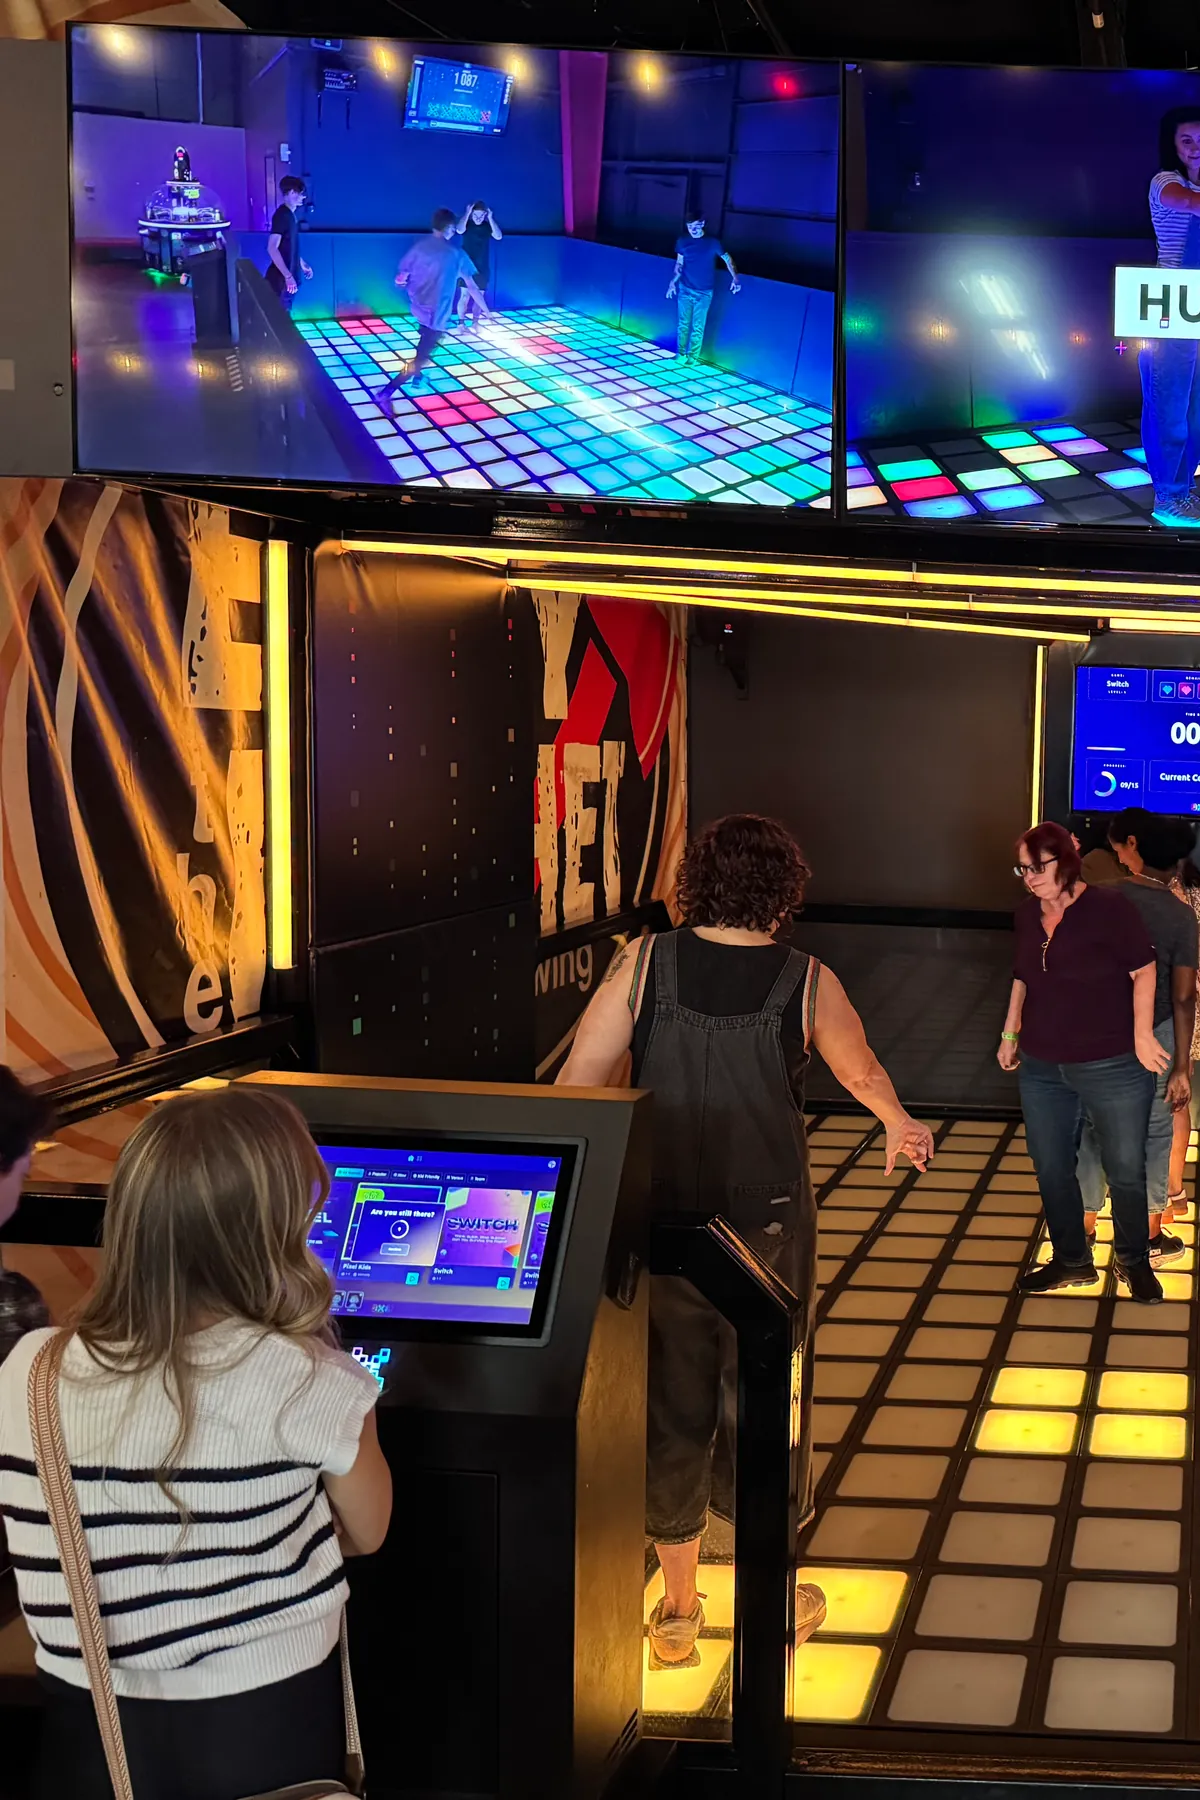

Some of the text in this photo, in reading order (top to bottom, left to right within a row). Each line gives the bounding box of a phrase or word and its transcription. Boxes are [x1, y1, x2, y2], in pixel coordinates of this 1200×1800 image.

[1106, 680, 1130, 688] Switch
[1160, 772, 1191, 782] Current
[1120, 781, 1139, 790] 09/15
[370, 1208, 436, 1218] Are you still there?
[447, 1217, 519, 1232] SWITCH
[433, 1267, 454, 1275] Switch
